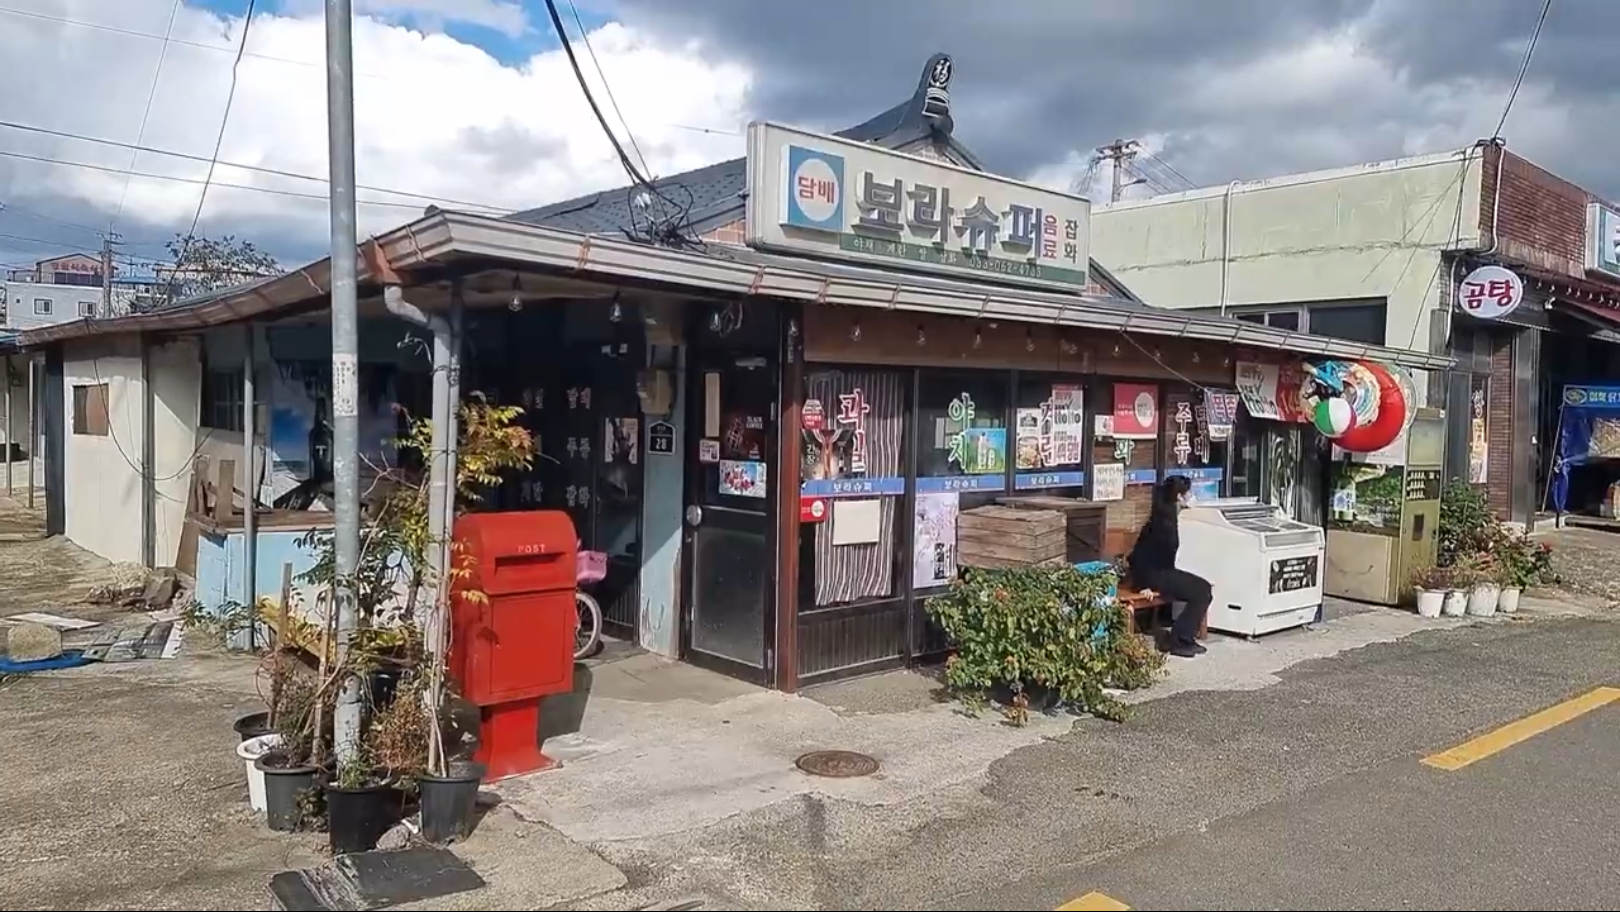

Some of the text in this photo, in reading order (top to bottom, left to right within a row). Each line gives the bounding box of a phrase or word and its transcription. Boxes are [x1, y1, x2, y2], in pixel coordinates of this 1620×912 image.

[798, 176, 835, 205] 담배
[858, 171, 1043, 258] 보라슈퍼
[1042, 214, 1058, 259] 음료
[1063, 219, 1079, 264] 잡화
[1464, 279, 1515, 310] 곰탕
[655, 437, 668, 450] 28
[837, 388, 870, 473] 과일
[1173, 402, 1192, 465] 주류
[518, 544, 545, 553] POST
